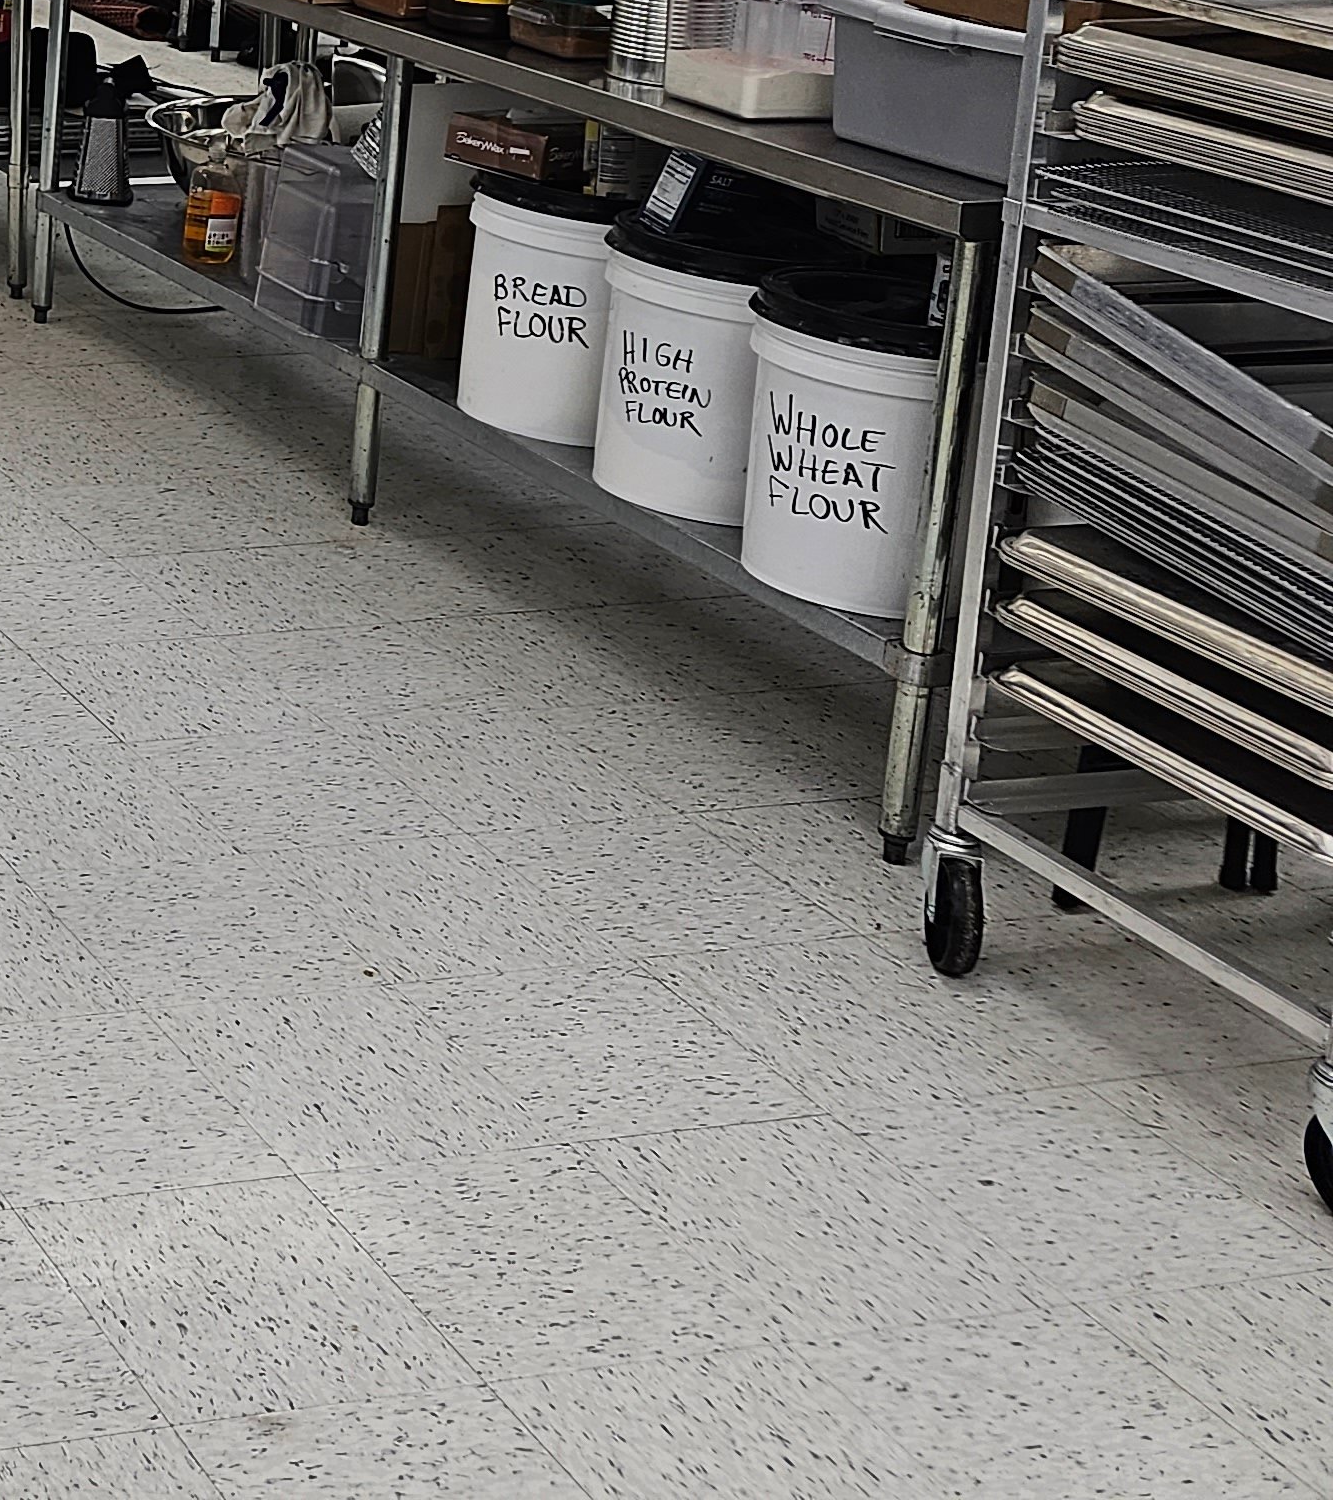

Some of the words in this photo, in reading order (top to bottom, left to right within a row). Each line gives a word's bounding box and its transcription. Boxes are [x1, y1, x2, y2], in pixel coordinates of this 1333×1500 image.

[709, 174, 734, 188] SALT
[494, 273, 587, 308] BREAD
[497, 307, 590, 349] FLOUR
[623, 330, 693, 373] HIGH
[618, 366, 712, 409] PROTEIN
[624, 400, 703, 438] FLOUR
[769, 390, 887, 453] WHOLE
[767, 434, 896, 493] WHEAT
[768, 475, 889, 535] FLOUR
